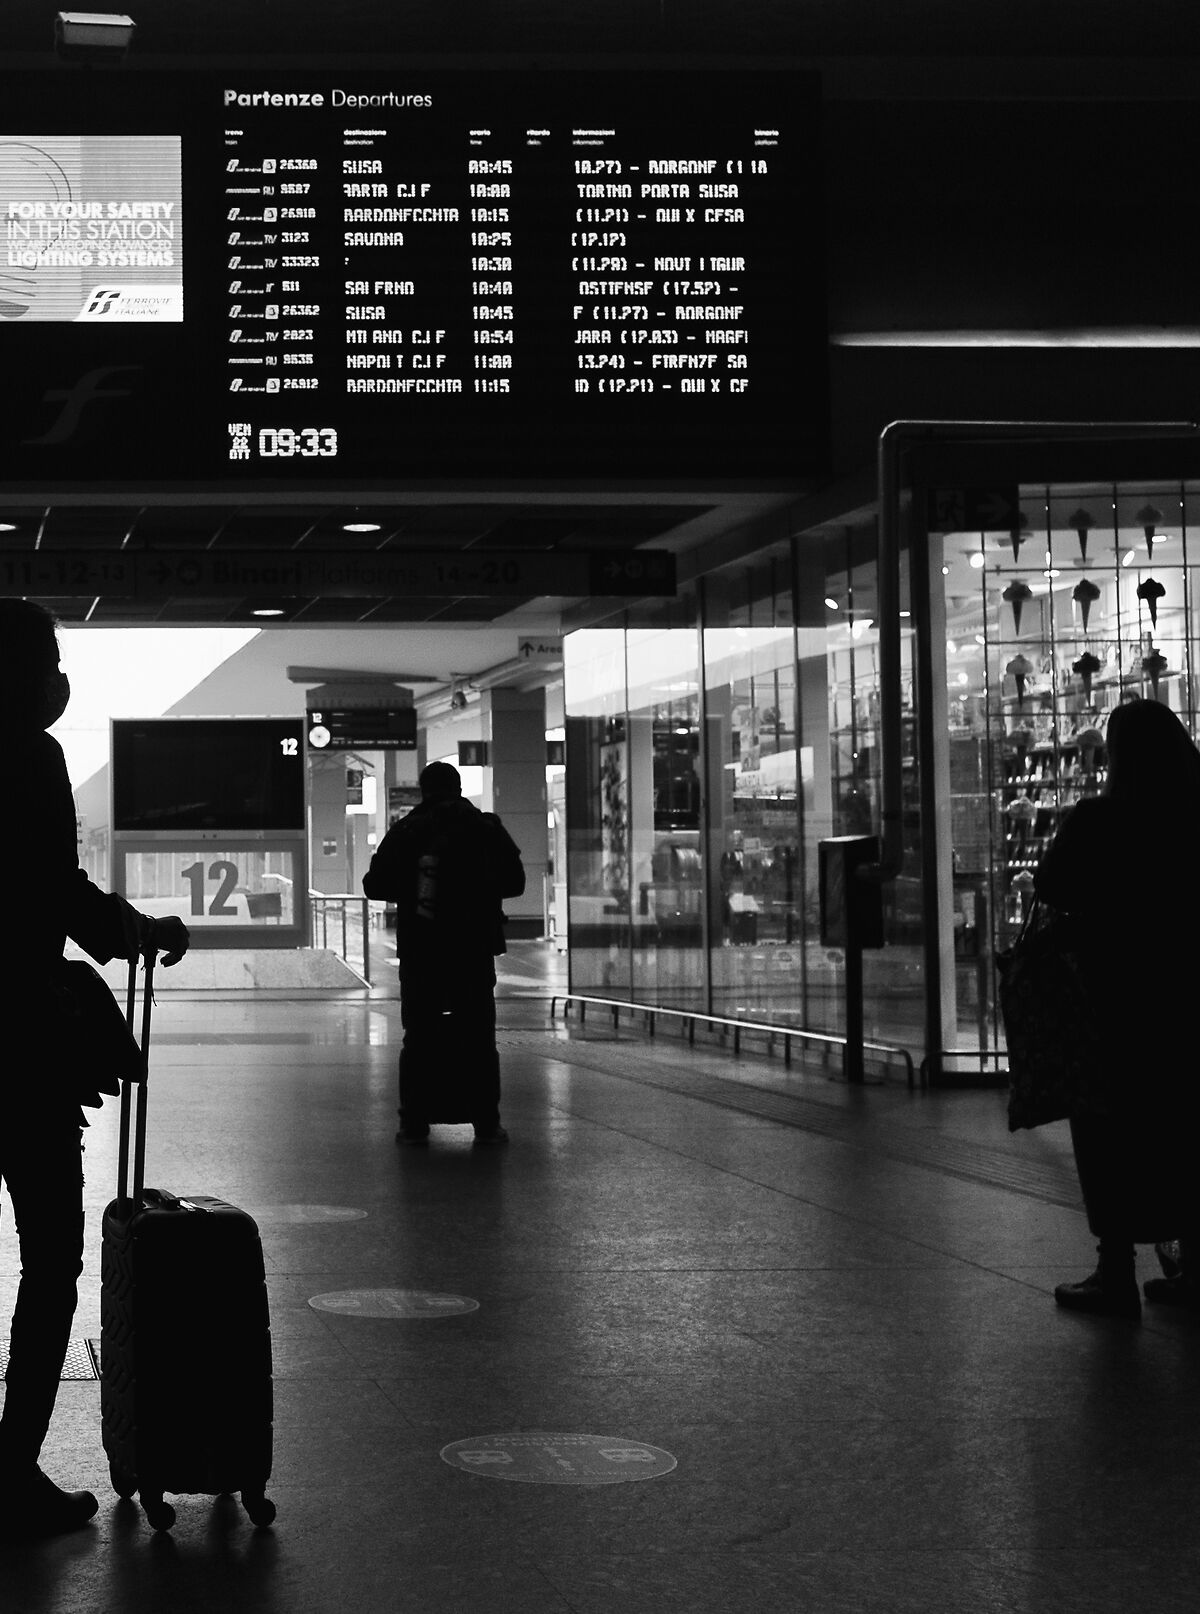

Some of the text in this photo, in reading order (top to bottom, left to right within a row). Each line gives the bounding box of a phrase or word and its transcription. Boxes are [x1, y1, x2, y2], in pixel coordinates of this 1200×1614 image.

[224, 89, 433, 109] Partenze Departures
[343, 129, 387, 137] destinazione
[468, 129, 492, 137] orario
[526, 129, 551, 137] ritardo
[571, 129, 616, 137] informazioni
[753, 129, 780, 137] binario
[8, 202, 175, 219] FOR YOUR SAFETY
[8, 220, 174, 240] IN THIS STATION
[281, 231, 310, 243] 3123
[7, 251, 175, 266] LIGHTING SYSTEMS
[258, 428, 338, 457] 09:33
[212, 559, 302, 585] Binari
[303, 559, 418, 586] Platforms
[279, 738, 298, 756] 12
[181, 860, 239, 916] 12
